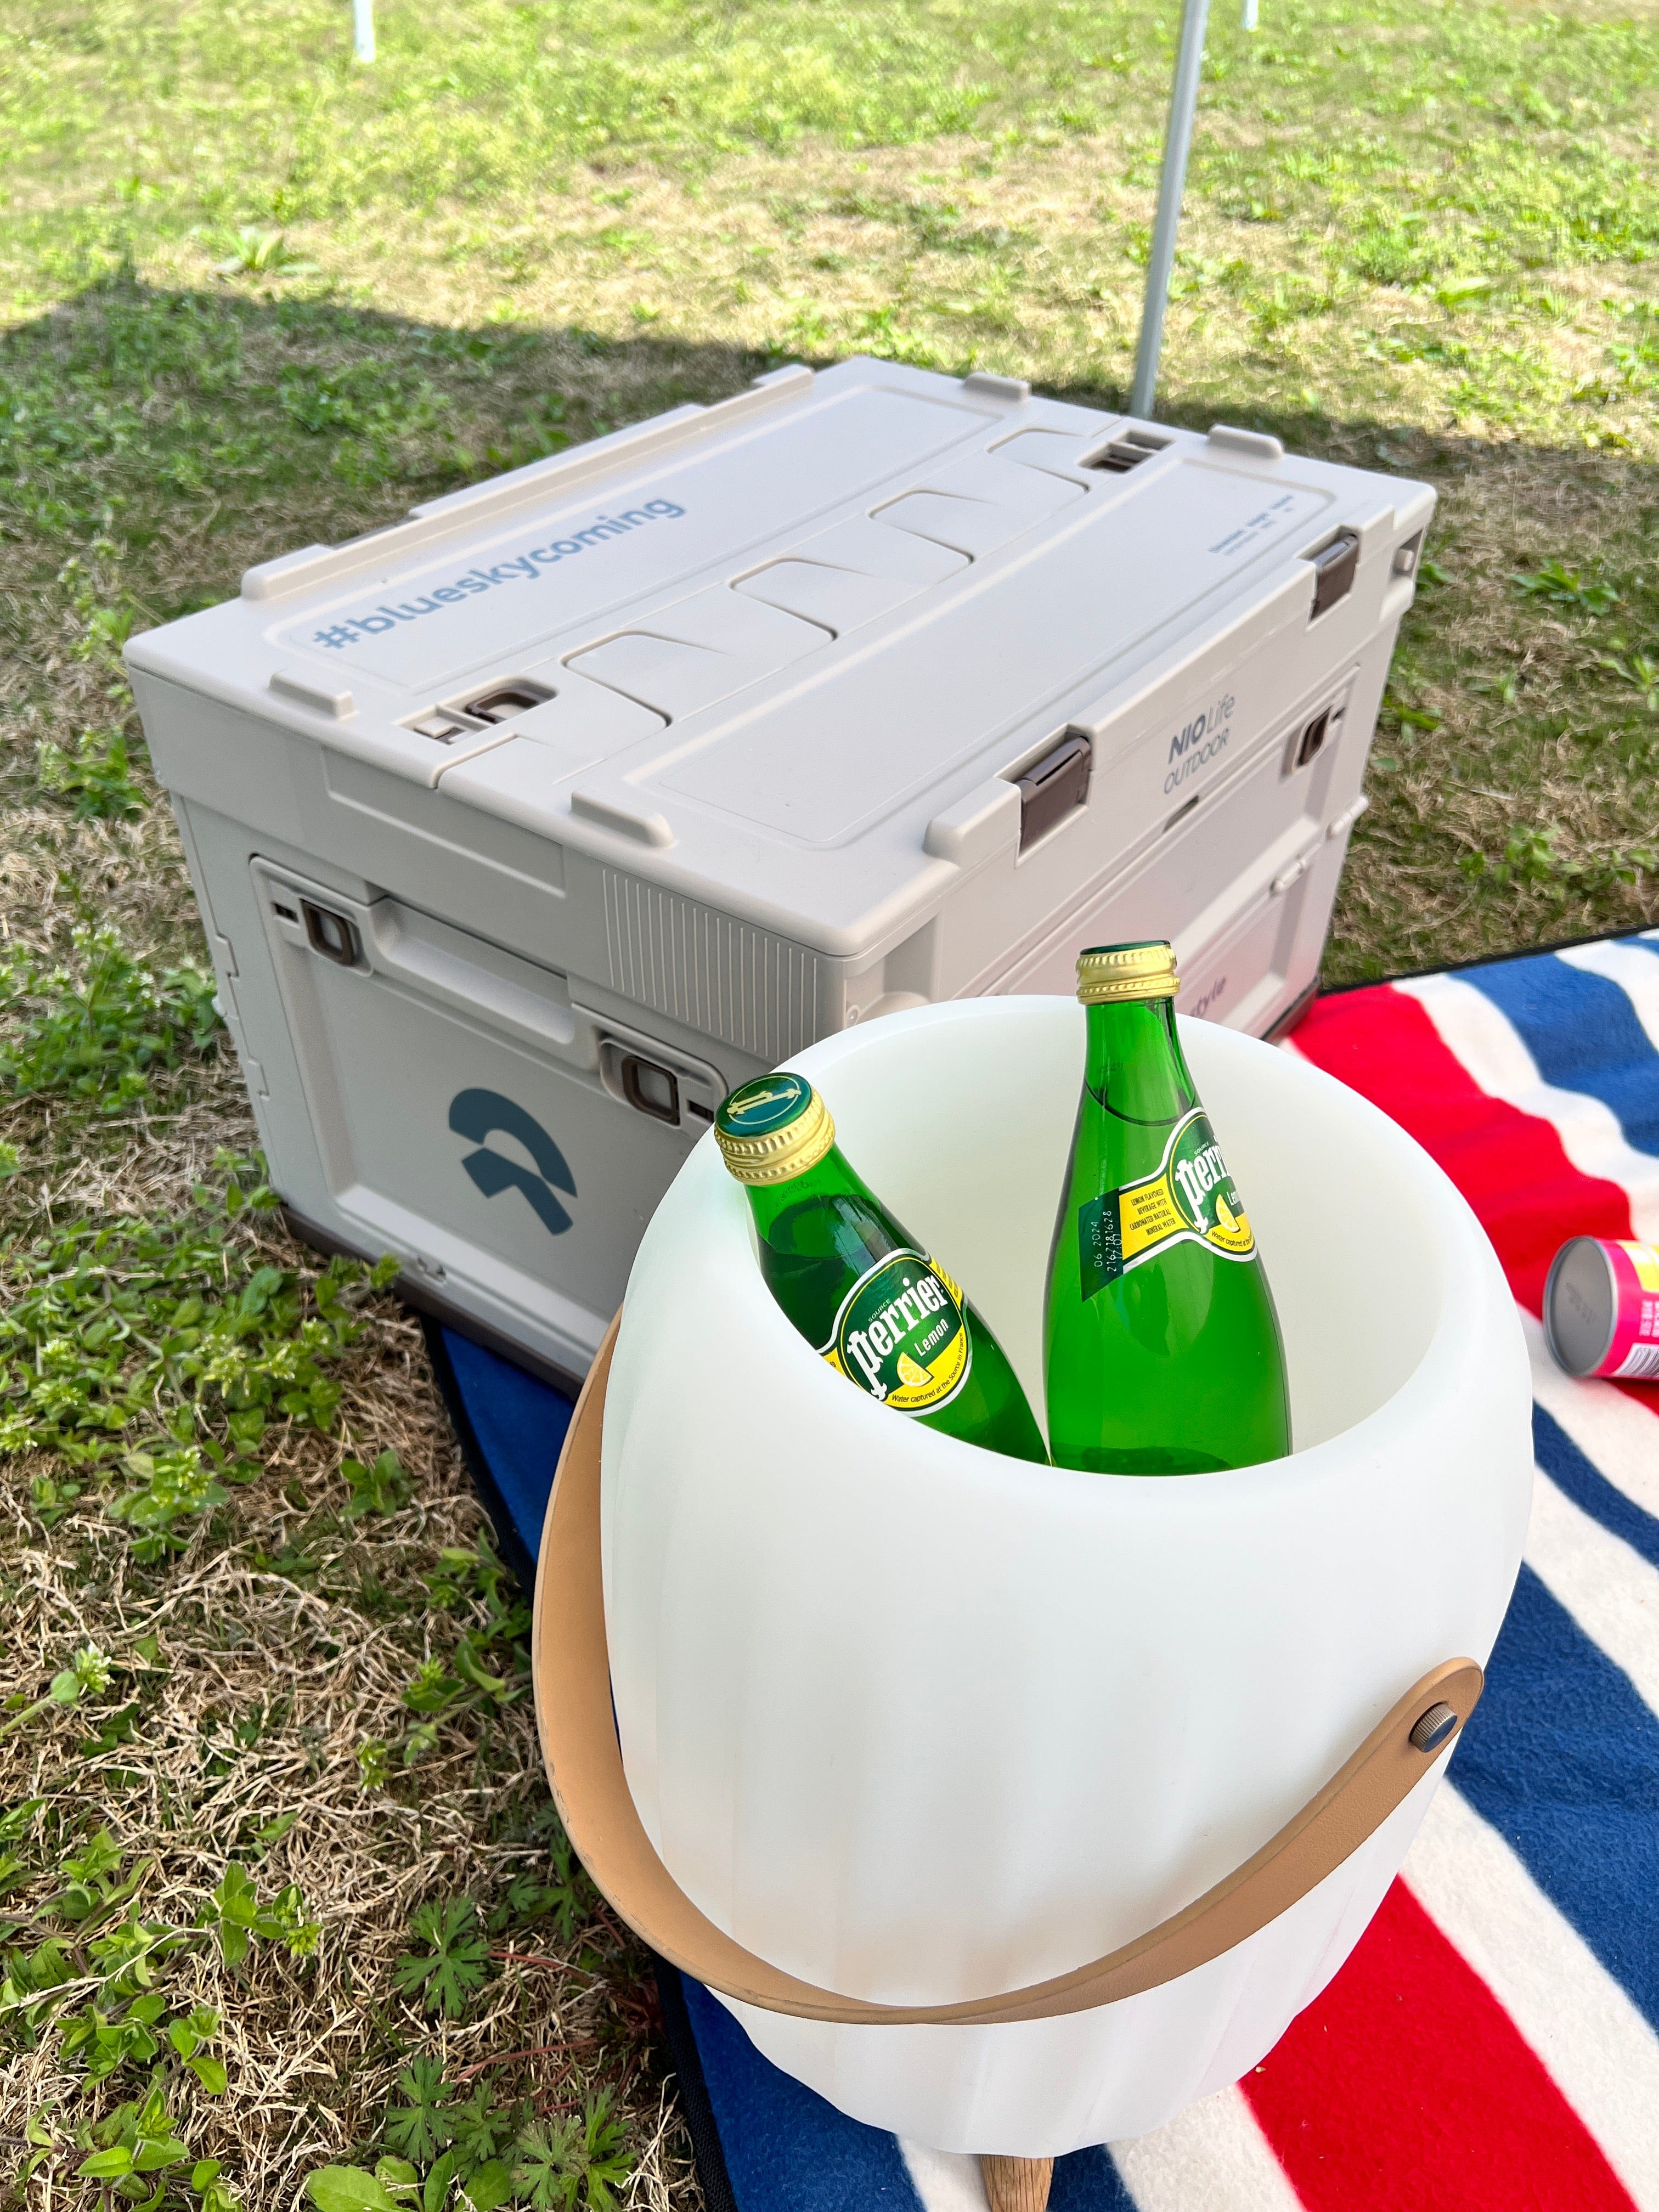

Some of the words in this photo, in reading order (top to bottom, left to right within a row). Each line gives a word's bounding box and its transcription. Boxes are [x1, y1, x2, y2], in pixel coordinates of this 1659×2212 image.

[313, 498, 686, 650] #blueskycoming
[1167, 714, 1205, 765] NIO
[1206, 692, 1235, 734] Life
[1164, 727, 1229, 794] OUTDOOR
[1130, 1195, 1146, 1206] LEMON
[1144, 1188, 1164, 1201] FLAVORED
[1137, 1202, 1157, 1215] BEVERAGE
[1129, 1215, 1154, 1231] CARBONATED
[1153, 1209, 1171, 1220] NATURAL
[1145, 1223, 1164, 1235] MINERAL
[1161, 1218, 1177, 1228] WATER
[1091, 1222, 1102, 1246] 2024
[1211, 1231, 1225, 1243] Water
[1226, 1239, 1243, 1247] captured
[1093, 1253, 1103, 1267] 06
[868, 1298, 891, 1323] SOURCE
[914, 1318, 949, 1357] Lemon
[891, 1394, 910, 1403] Water
[911, 1389, 935, 1403] captured
[936, 1386, 943, 1394] at
[941, 1379, 950, 1389] the
[949, 1362, 961, 1381] Source
